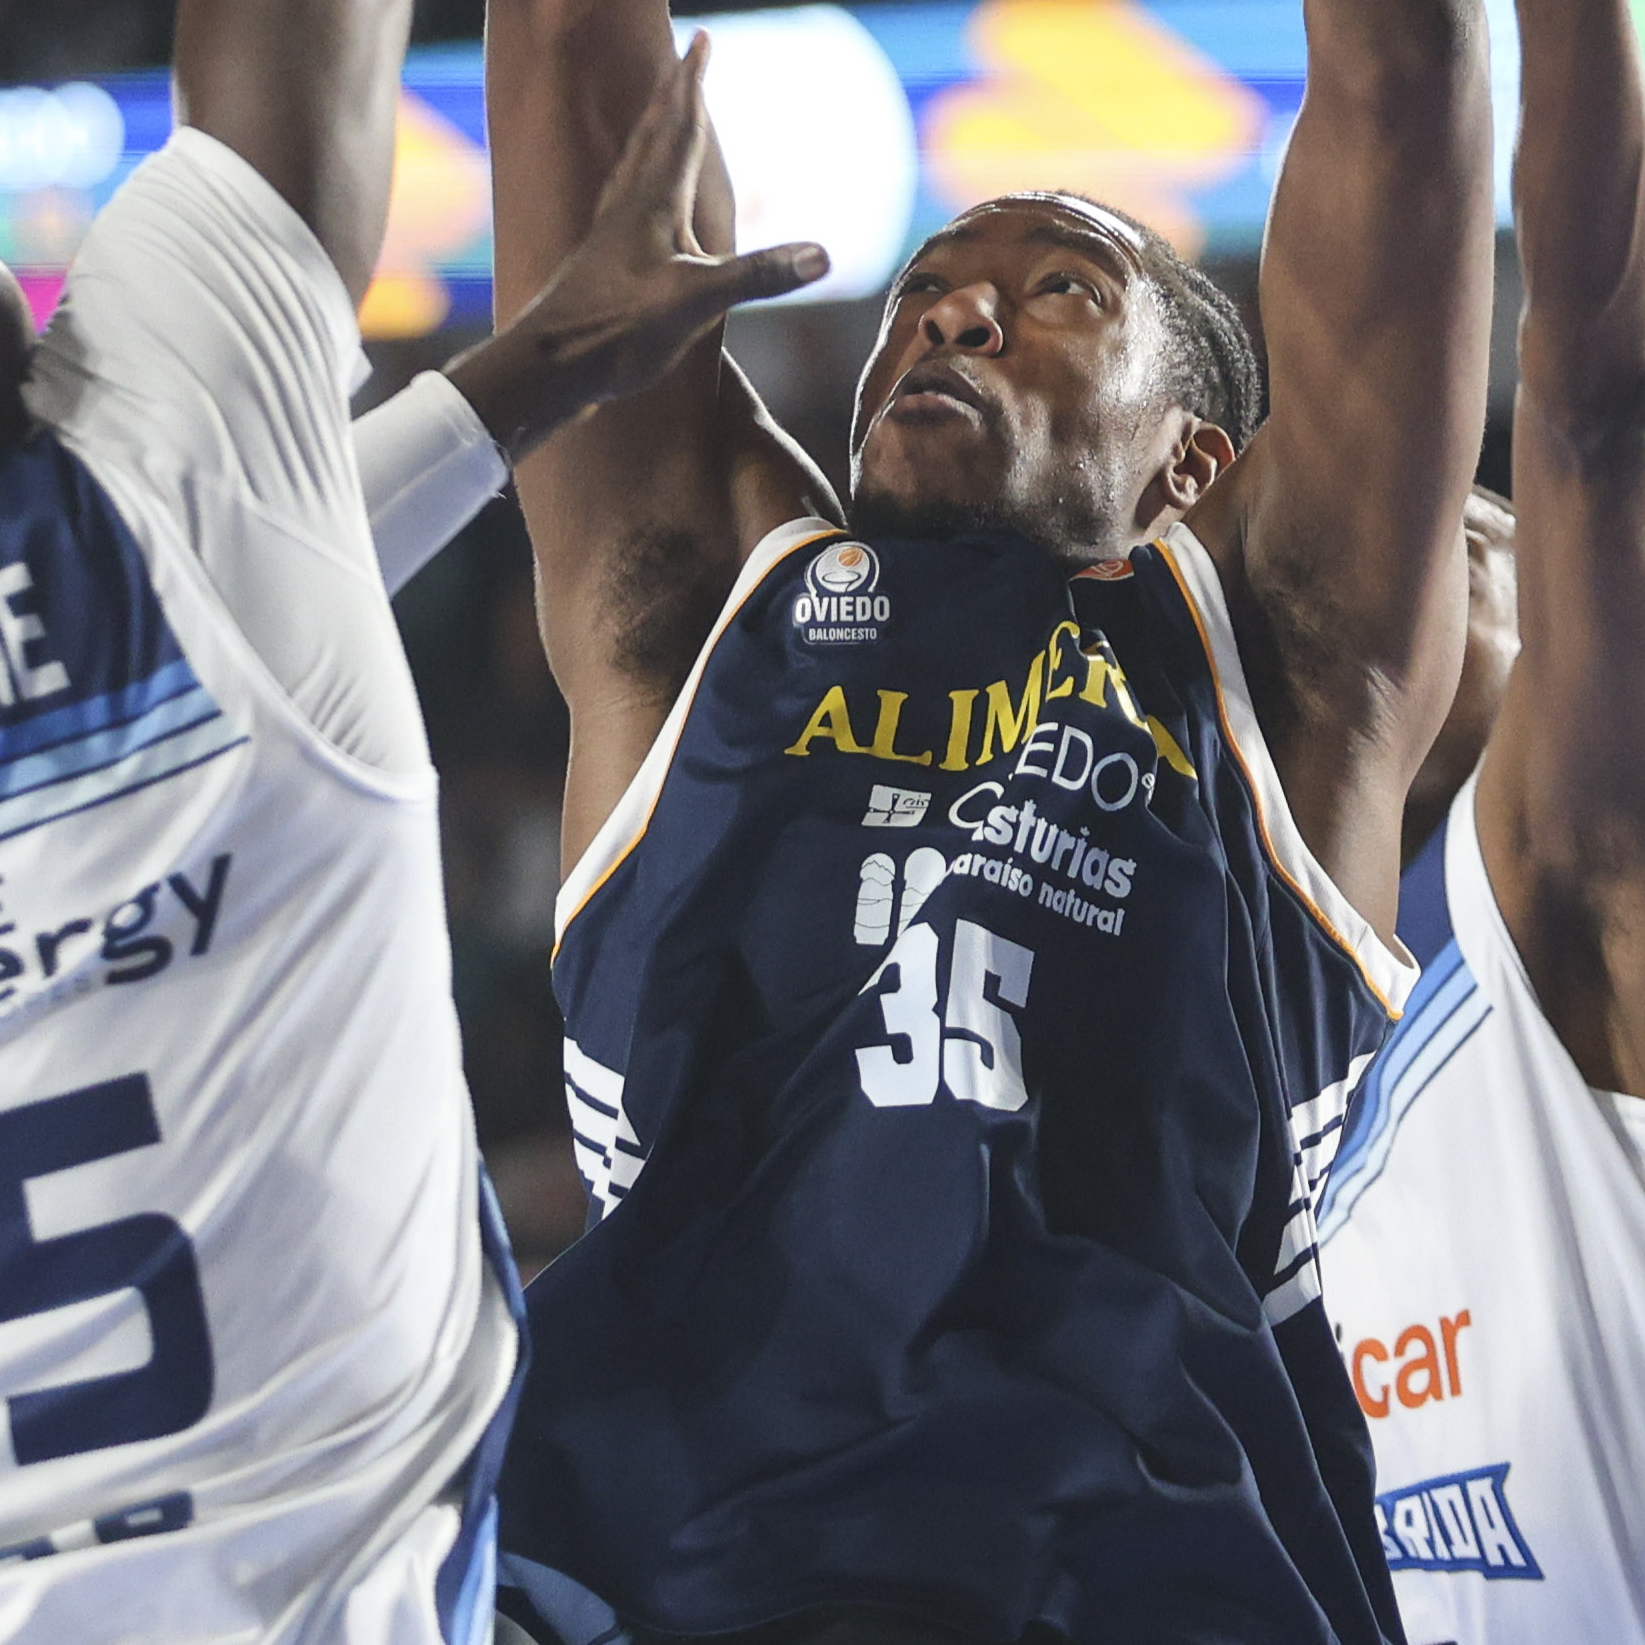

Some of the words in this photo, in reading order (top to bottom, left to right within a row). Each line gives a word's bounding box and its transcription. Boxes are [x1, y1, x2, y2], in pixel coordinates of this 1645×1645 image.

[795, 595, 891, 623] OVIEDO
[808, 627, 878, 643] BALONCESTO
[945, 852, 1033, 898] araíso
[1037, 880, 1127, 937] natural
[854, 918, 1036, 1113] 35
[1338, 1308, 1473, 1420] car
